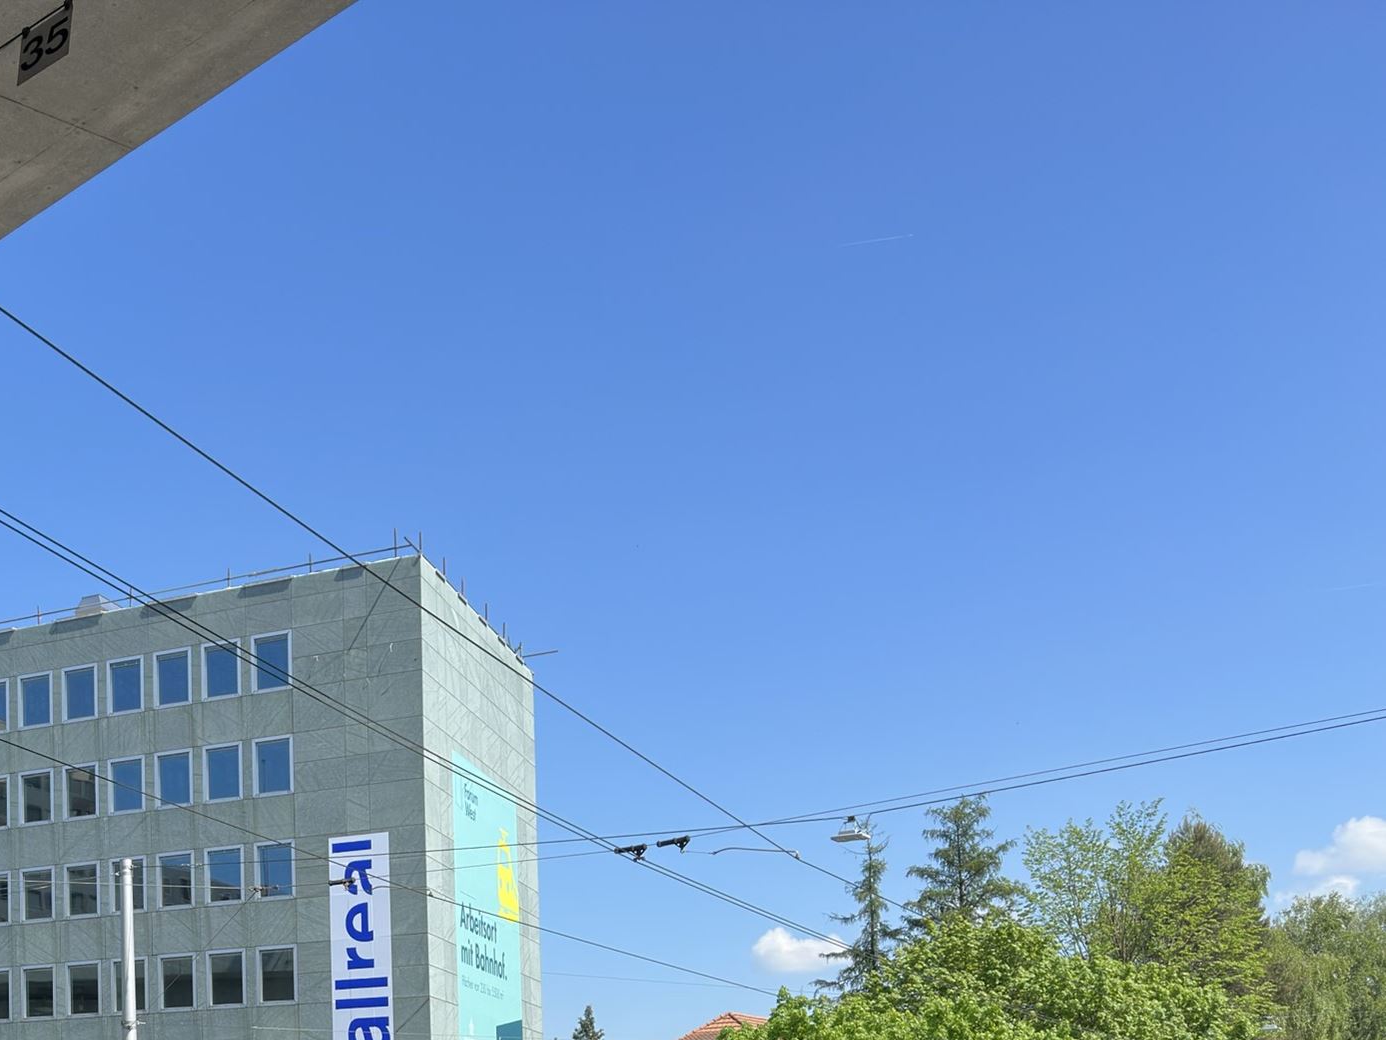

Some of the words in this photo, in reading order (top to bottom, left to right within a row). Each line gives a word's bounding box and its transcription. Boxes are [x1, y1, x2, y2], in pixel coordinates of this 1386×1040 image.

[20, 16, 69, 71] 35
[459, 902, 498, 944] Arbeitsort
[460, 941, 473, 968] mit
[475, 944, 508, 981] Bahnhof.
